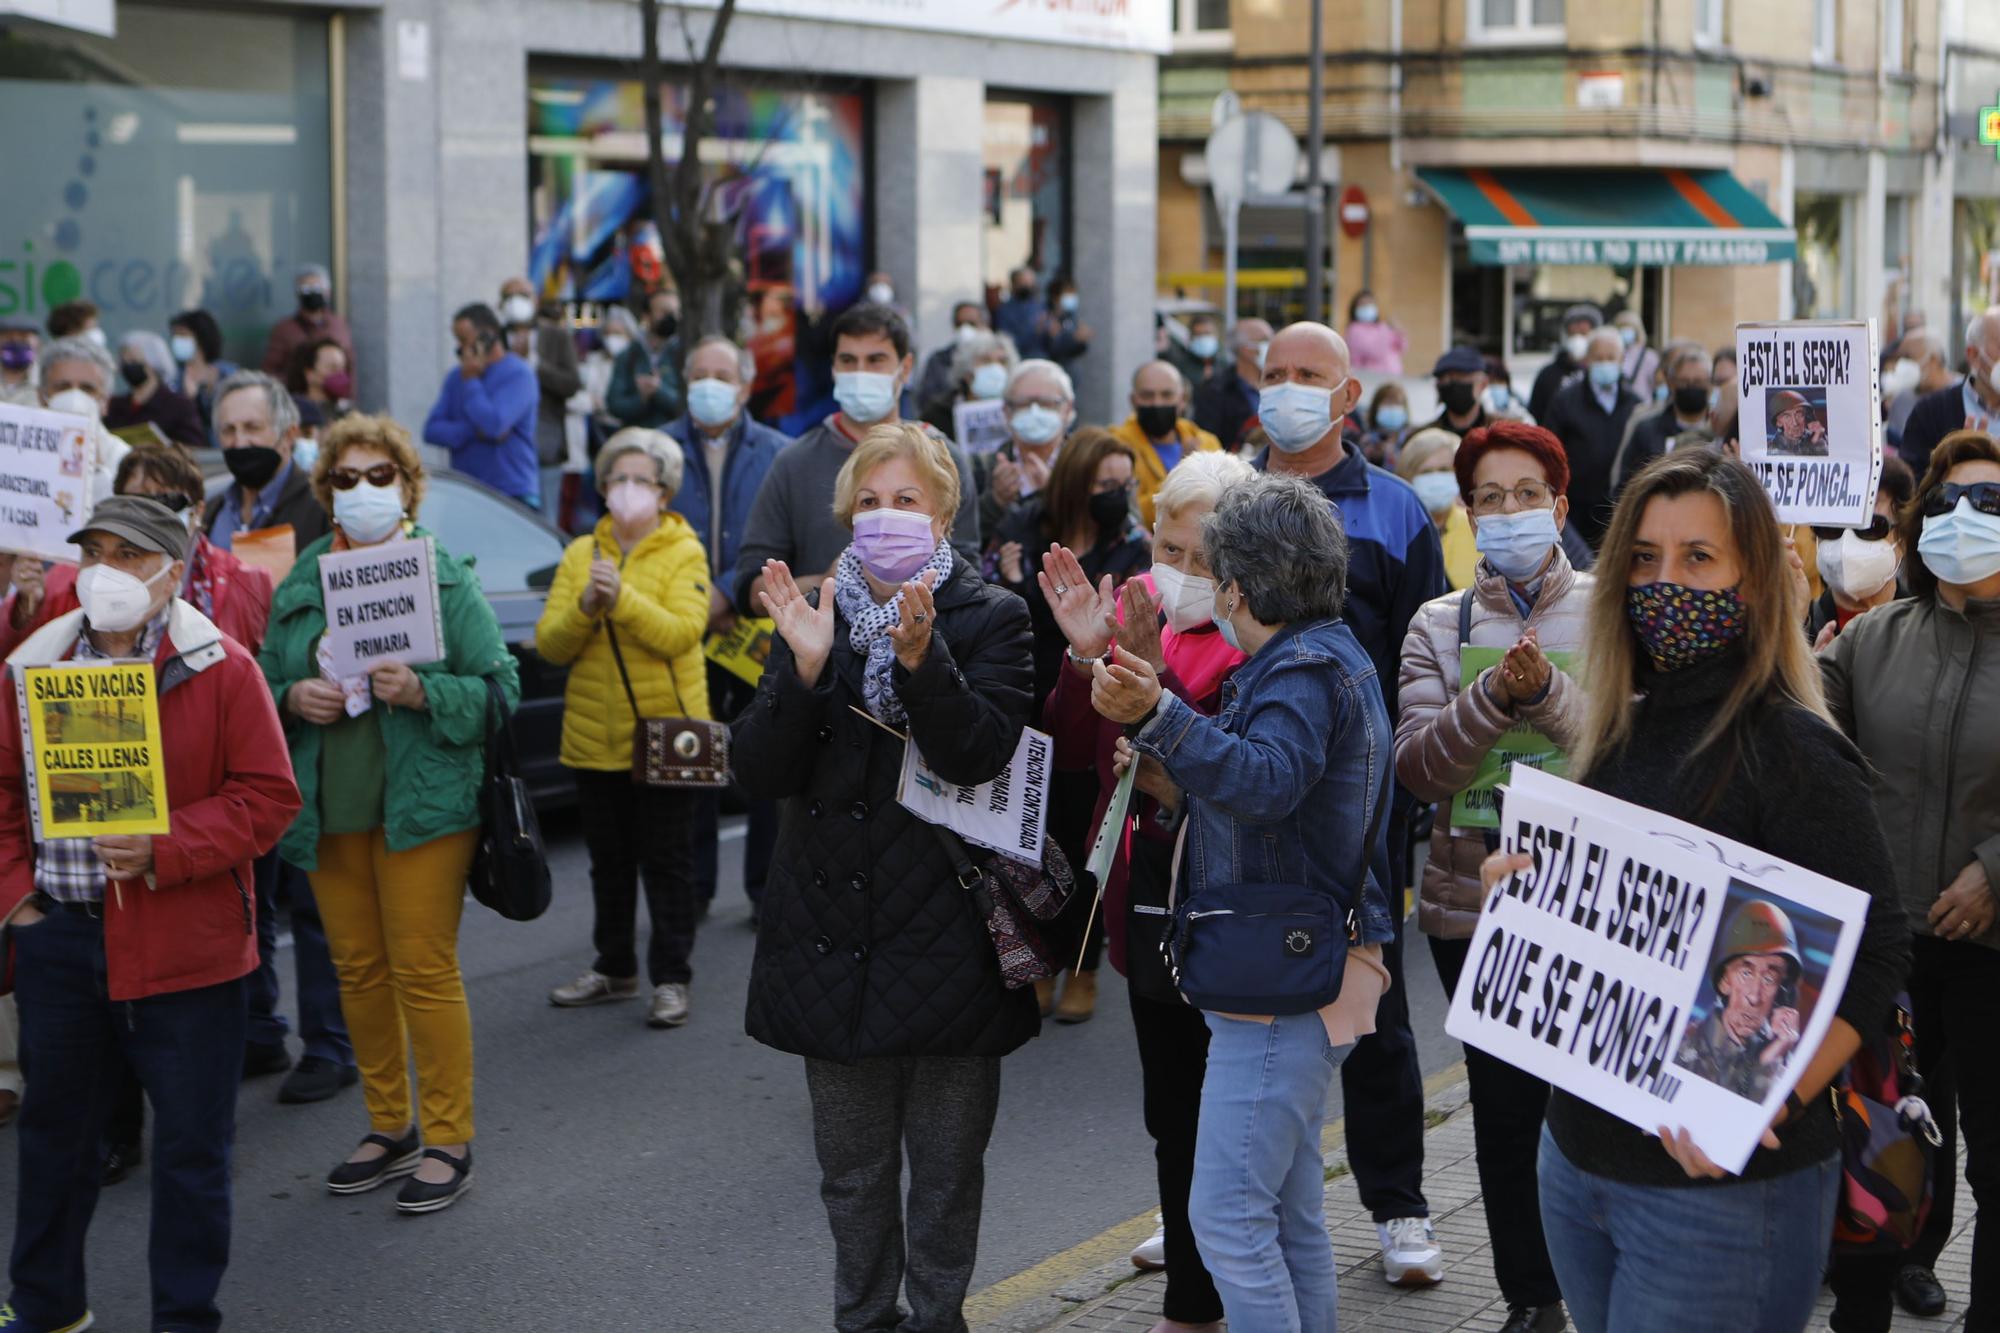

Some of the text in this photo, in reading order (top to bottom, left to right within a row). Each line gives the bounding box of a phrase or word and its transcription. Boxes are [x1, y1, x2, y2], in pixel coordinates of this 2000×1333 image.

[1743, 331, 1850, 398] ¿ESTÁ EL SESPA?
[1748, 462, 1772, 489] UE
[1774, 462, 1795, 507] SE
[327, 557, 420, 592] MÁS RECURSOS
[337, 591, 416, 627] EN ATENCIÓN
[353, 631, 411, 659] PRIMARIA
[34, 668, 147, 700] SALAS VACÍAS
[43, 747, 150, 770] CALLES LLENAS
[1018, 735, 1047, 851] ATENCIÓN CONTINUADA
[1465, 789, 1497, 810] CALIDA
[1571, 842, 1609, 933] EL
[1606, 857, 1707, 972] SESPA?
[1286, 930, 1311, 945] FASHION
[1471, 927, 1543, 1029] QUE
[1531, 953, 1582, 1049] SE
